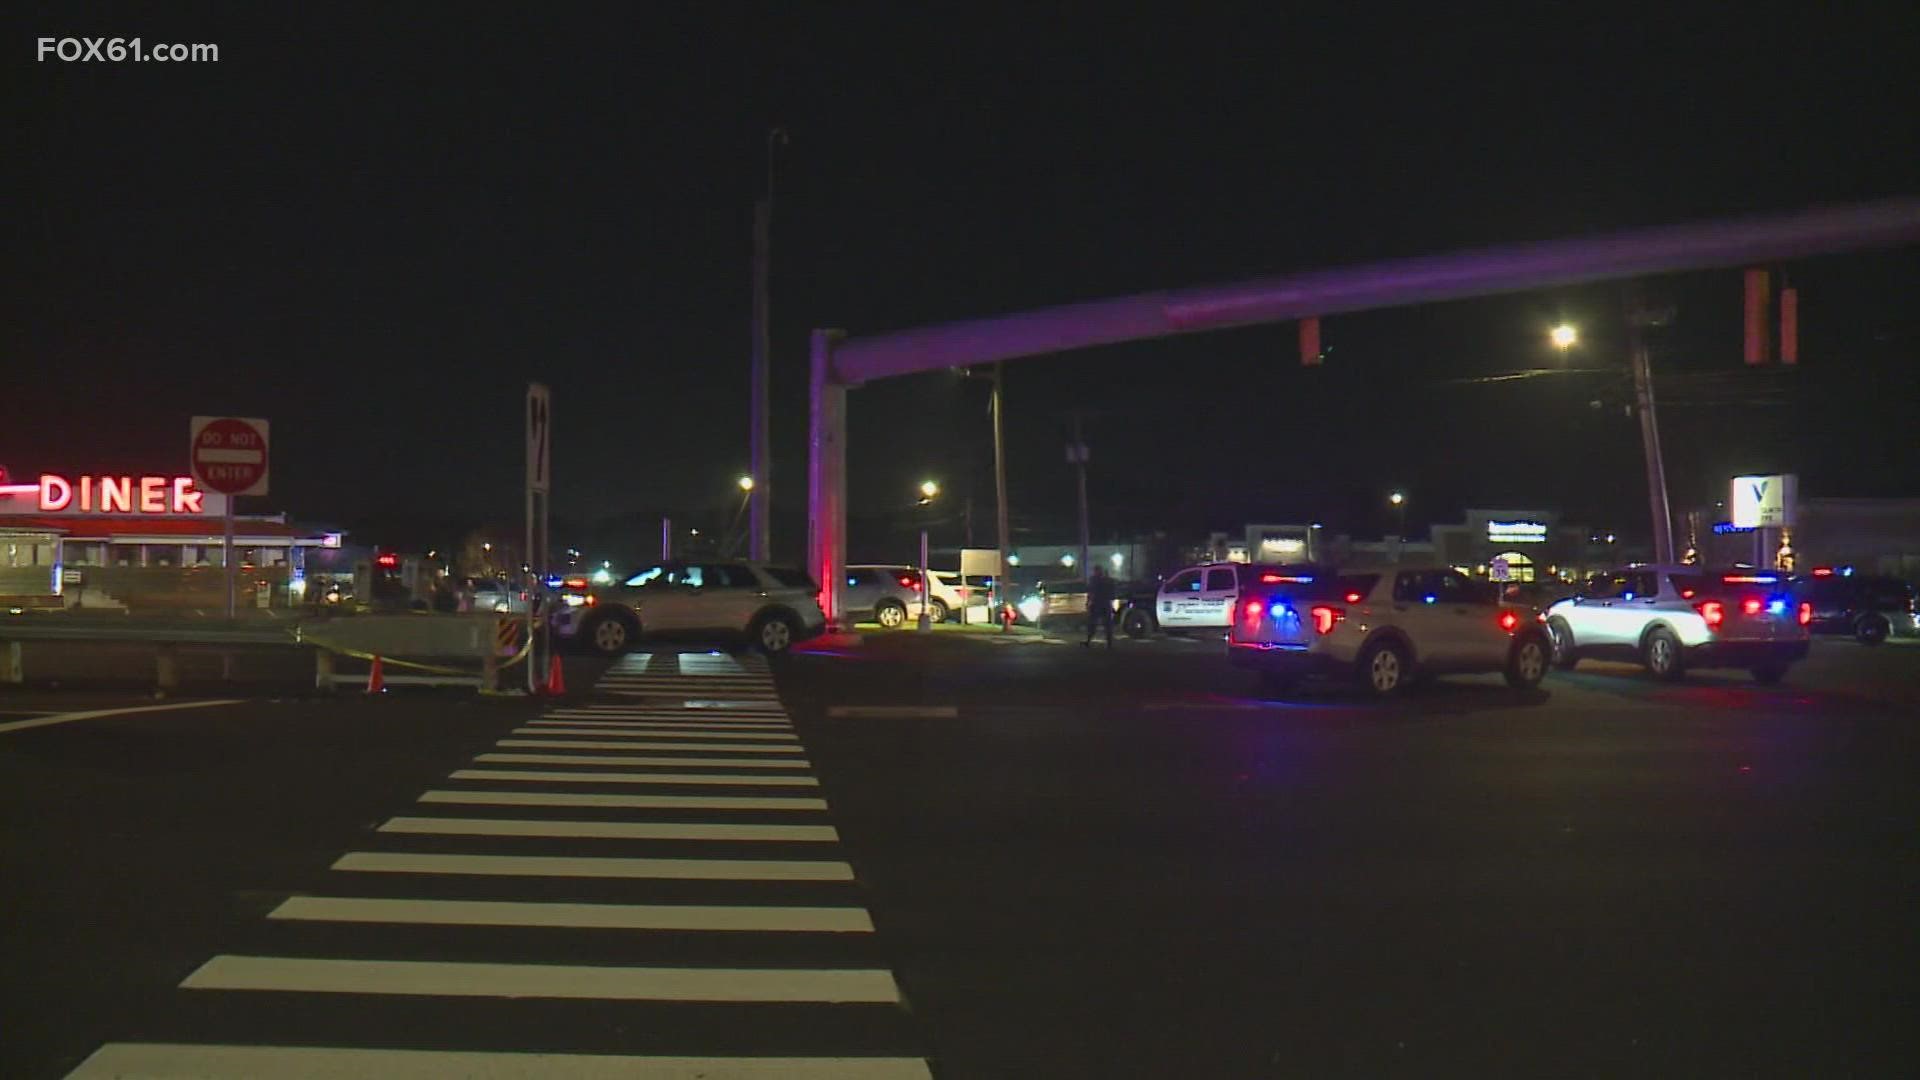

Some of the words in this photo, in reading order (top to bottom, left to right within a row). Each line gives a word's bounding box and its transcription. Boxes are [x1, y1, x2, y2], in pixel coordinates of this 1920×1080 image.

[202, 431, 221, 446] DO
[230, 432, 256, 447] NOT
[207, 466, 252, 480] ENTER
[40, 475, 203, 513] DINER
